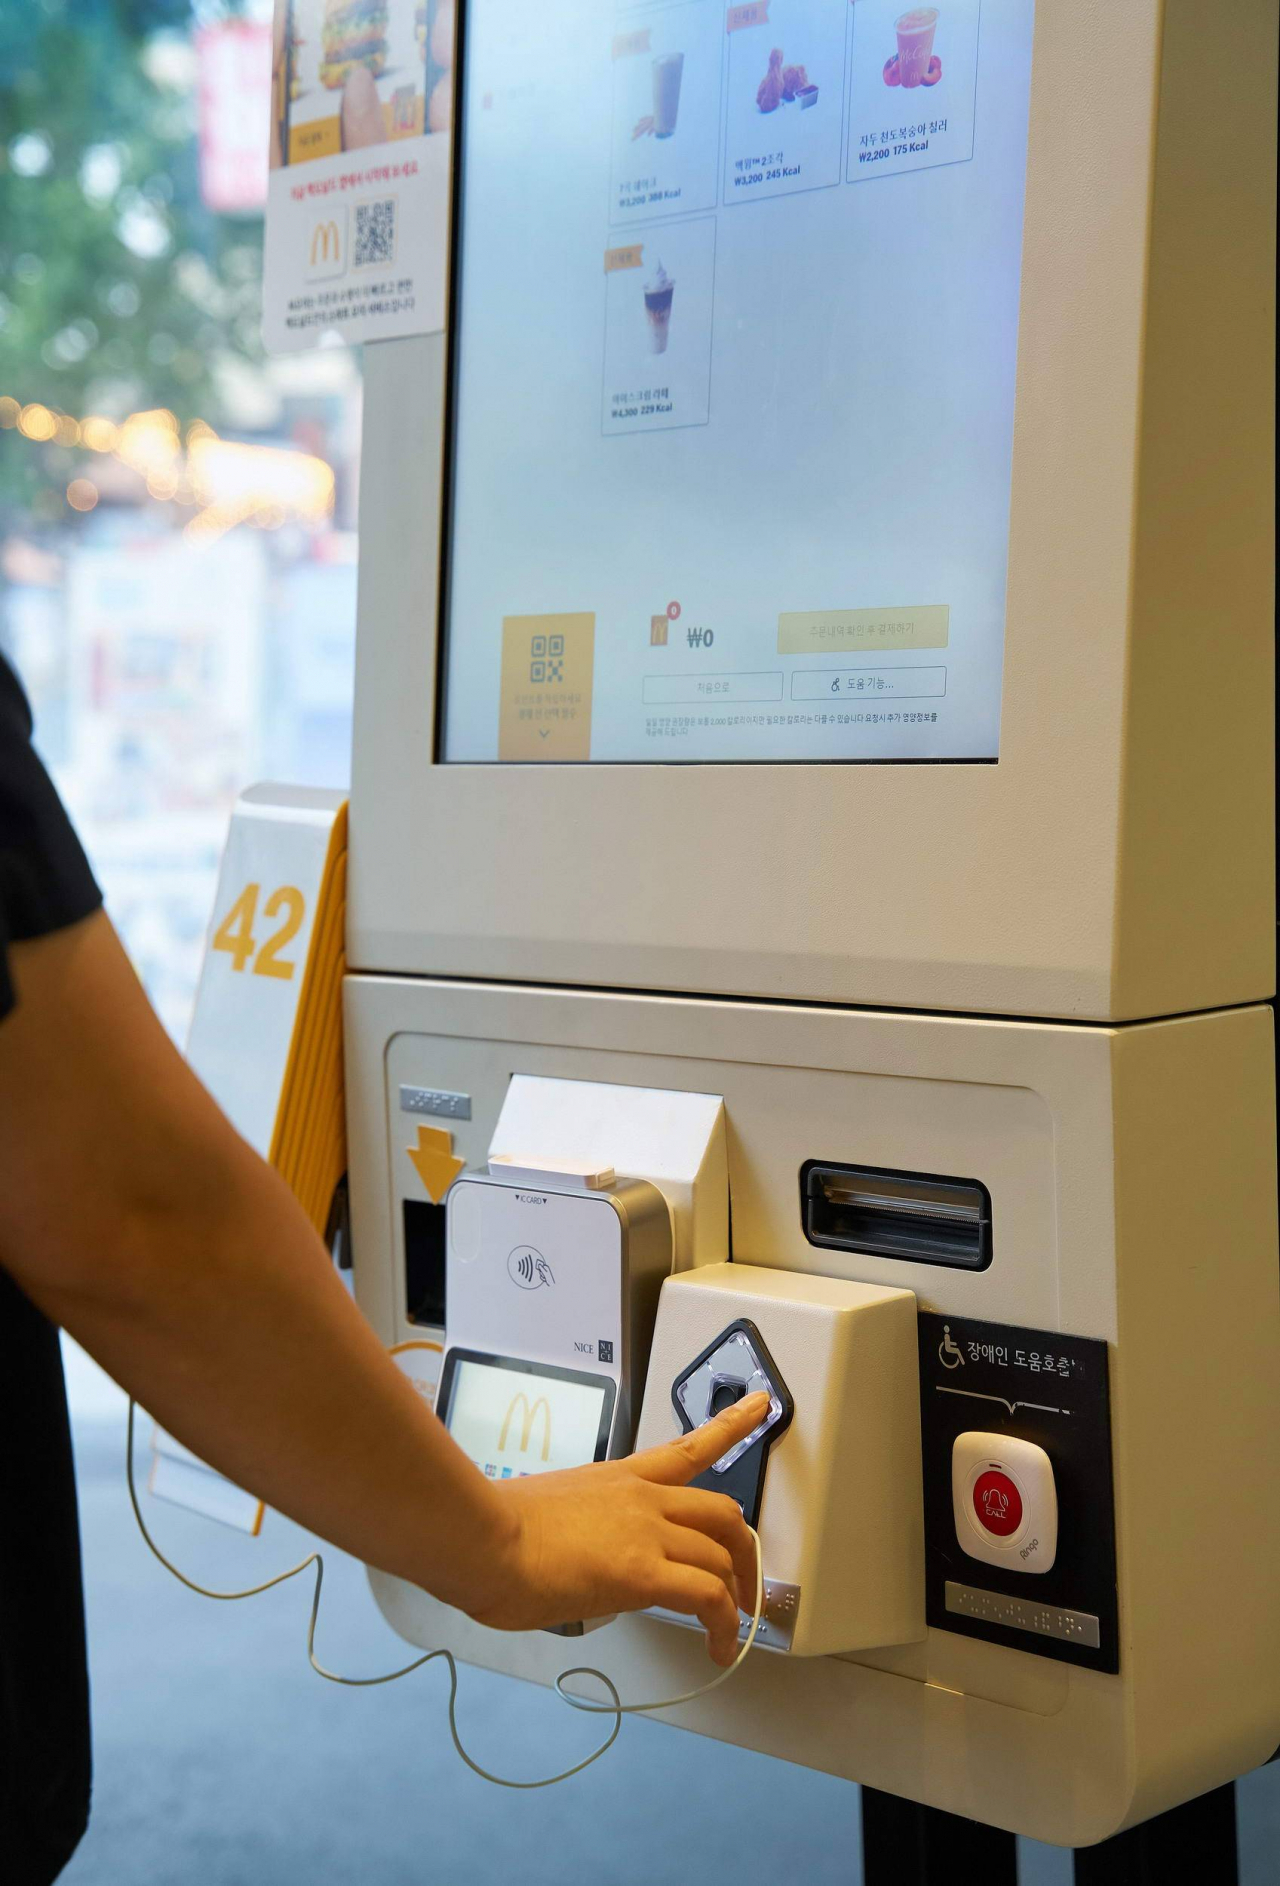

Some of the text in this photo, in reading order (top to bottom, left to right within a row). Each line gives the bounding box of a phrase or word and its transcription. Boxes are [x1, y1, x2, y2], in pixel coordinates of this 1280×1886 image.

[860, 119, 948, 147] 자두 천도복숭아 칠러
[859, 140, 928, 163] ₩2,200 175 Kcal
[734, 164, 800, 186] ₩3,200 245 Kcal
[664, 187, 682, 199] Kcal
[656, 402, 673, 412] Kcal
[686, 626, 714, 648] ₩0
[810, 622, 914, 638] 주문내역 확인 후 결제하기
[697, 682, 730, 694] 처음으로
[848, 677, 894, 690] 도움 기능...
[828, 714, 836, 724] 수
[837, 713, 864, 724] 있습니다
[865, 713, 886, 724] 요청시
[887, 713, 902, 723] 추가
[902, 712, 938, 723] 영양정보를
[213, 882, 305, 980] 42
[520, 1195, 542, 1205] IC CARD
[574, 1342, 594, 1354] NICE
[967, 1341, 1085, 1378] 장애인 도움호출
[986, 1509, 1006, 1519] CALL
[1020, 1539, 1039, 1560] Ringo
